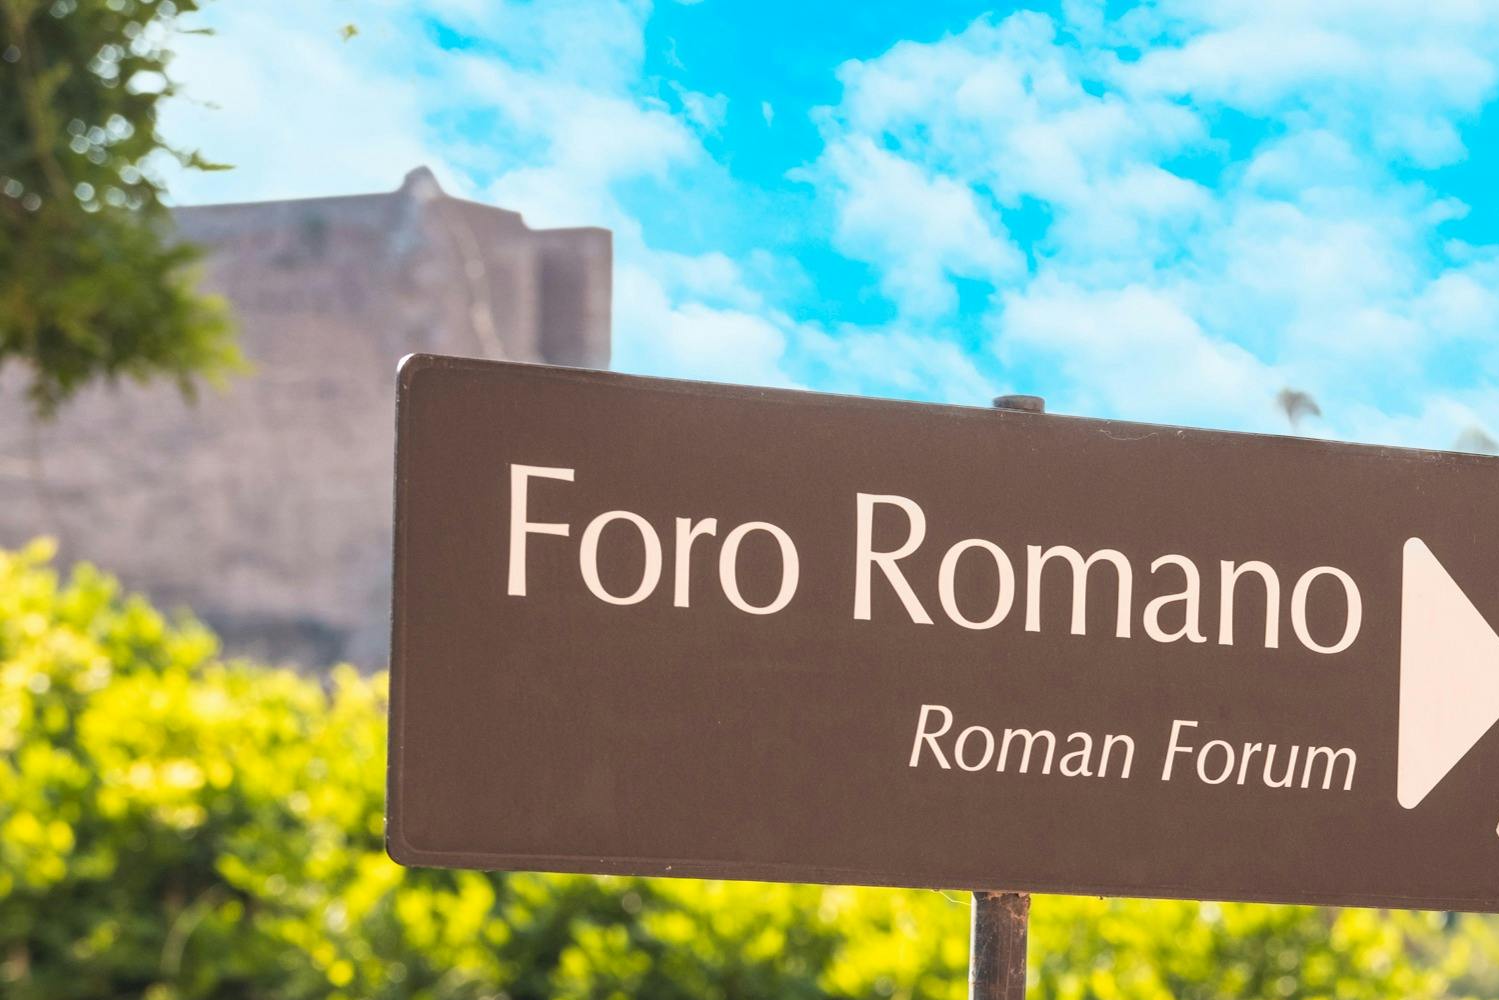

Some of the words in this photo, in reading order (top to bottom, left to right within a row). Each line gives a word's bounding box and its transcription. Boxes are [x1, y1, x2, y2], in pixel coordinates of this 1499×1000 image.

[506, 463, 801, 616] Foro
[853, 491, 1364, 656] Romano
[907, 703, 1136, 780] Roman
[1160, 719, 1358, 792] Forum
